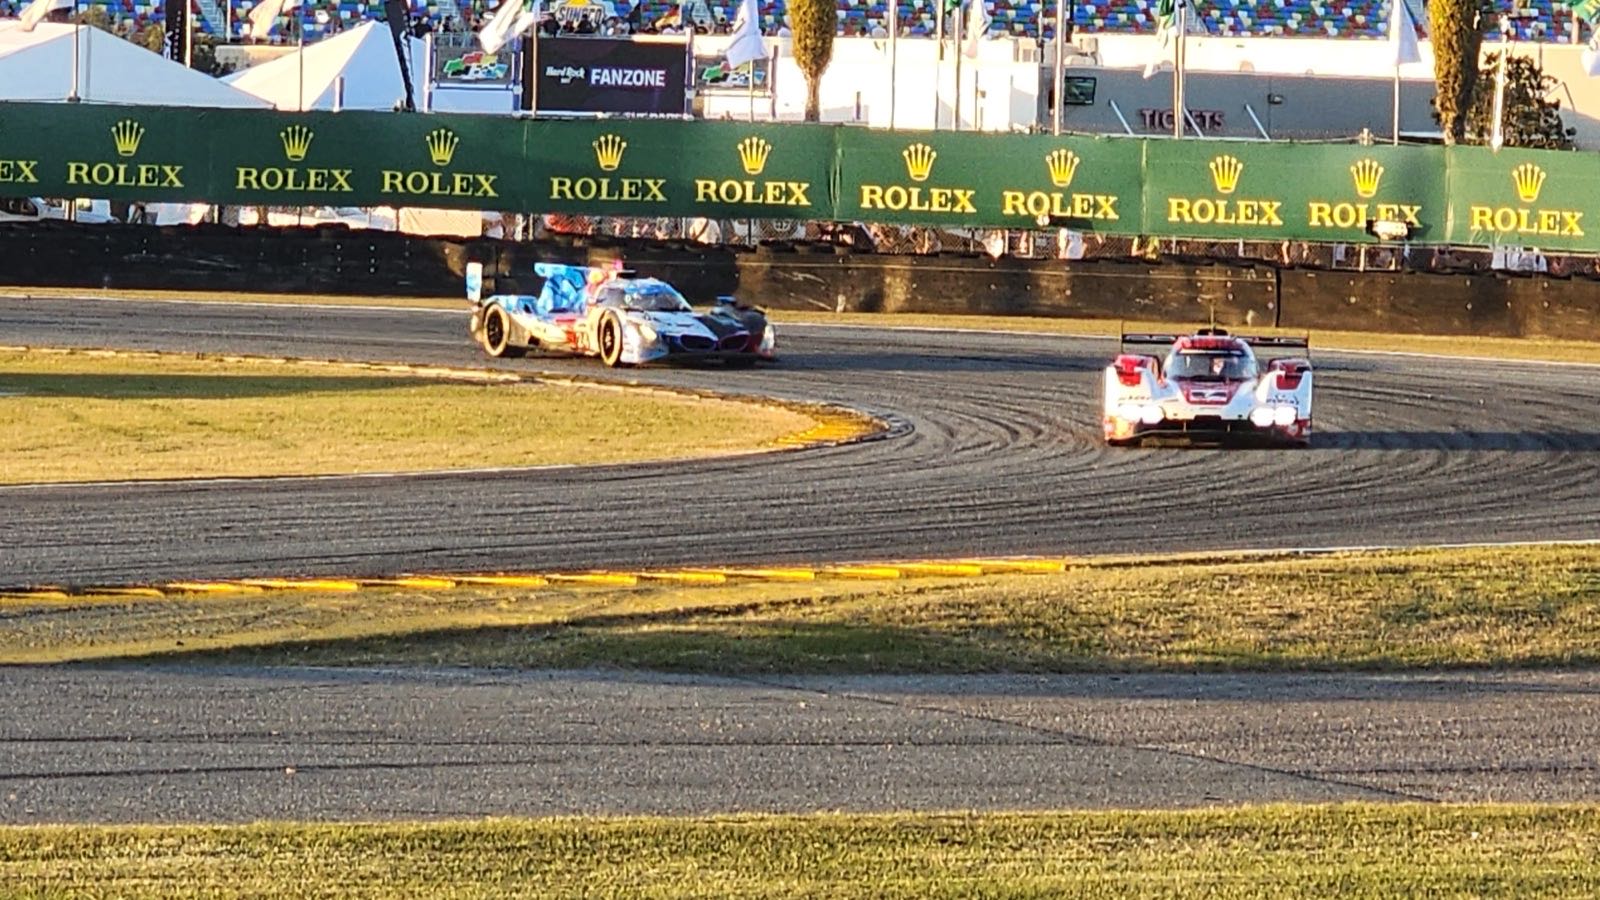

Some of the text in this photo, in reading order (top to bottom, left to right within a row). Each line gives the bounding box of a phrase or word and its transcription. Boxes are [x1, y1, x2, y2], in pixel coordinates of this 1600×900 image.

[590, 68, 666, 87] FANZONE
[1142, 108, 1225, 131] TICETS
[66, 161, 185, 188] ROLEX
[235, 166, 354, 192] ROLEX
[380, 171, 498, 197] ROLEX
[550, 177, 667, 201] ROLEX
[694, 179, 812, 206] ROLEX
[860, 184, 977, 213] ROLEX
[1002, 190, 1120, 220] ROLEX
[1167, 199, 1284, 226] ROLEX
[1308, 202, 1423, 228] ROLEX
[1470, 206, 1584, 236] ROLEX
